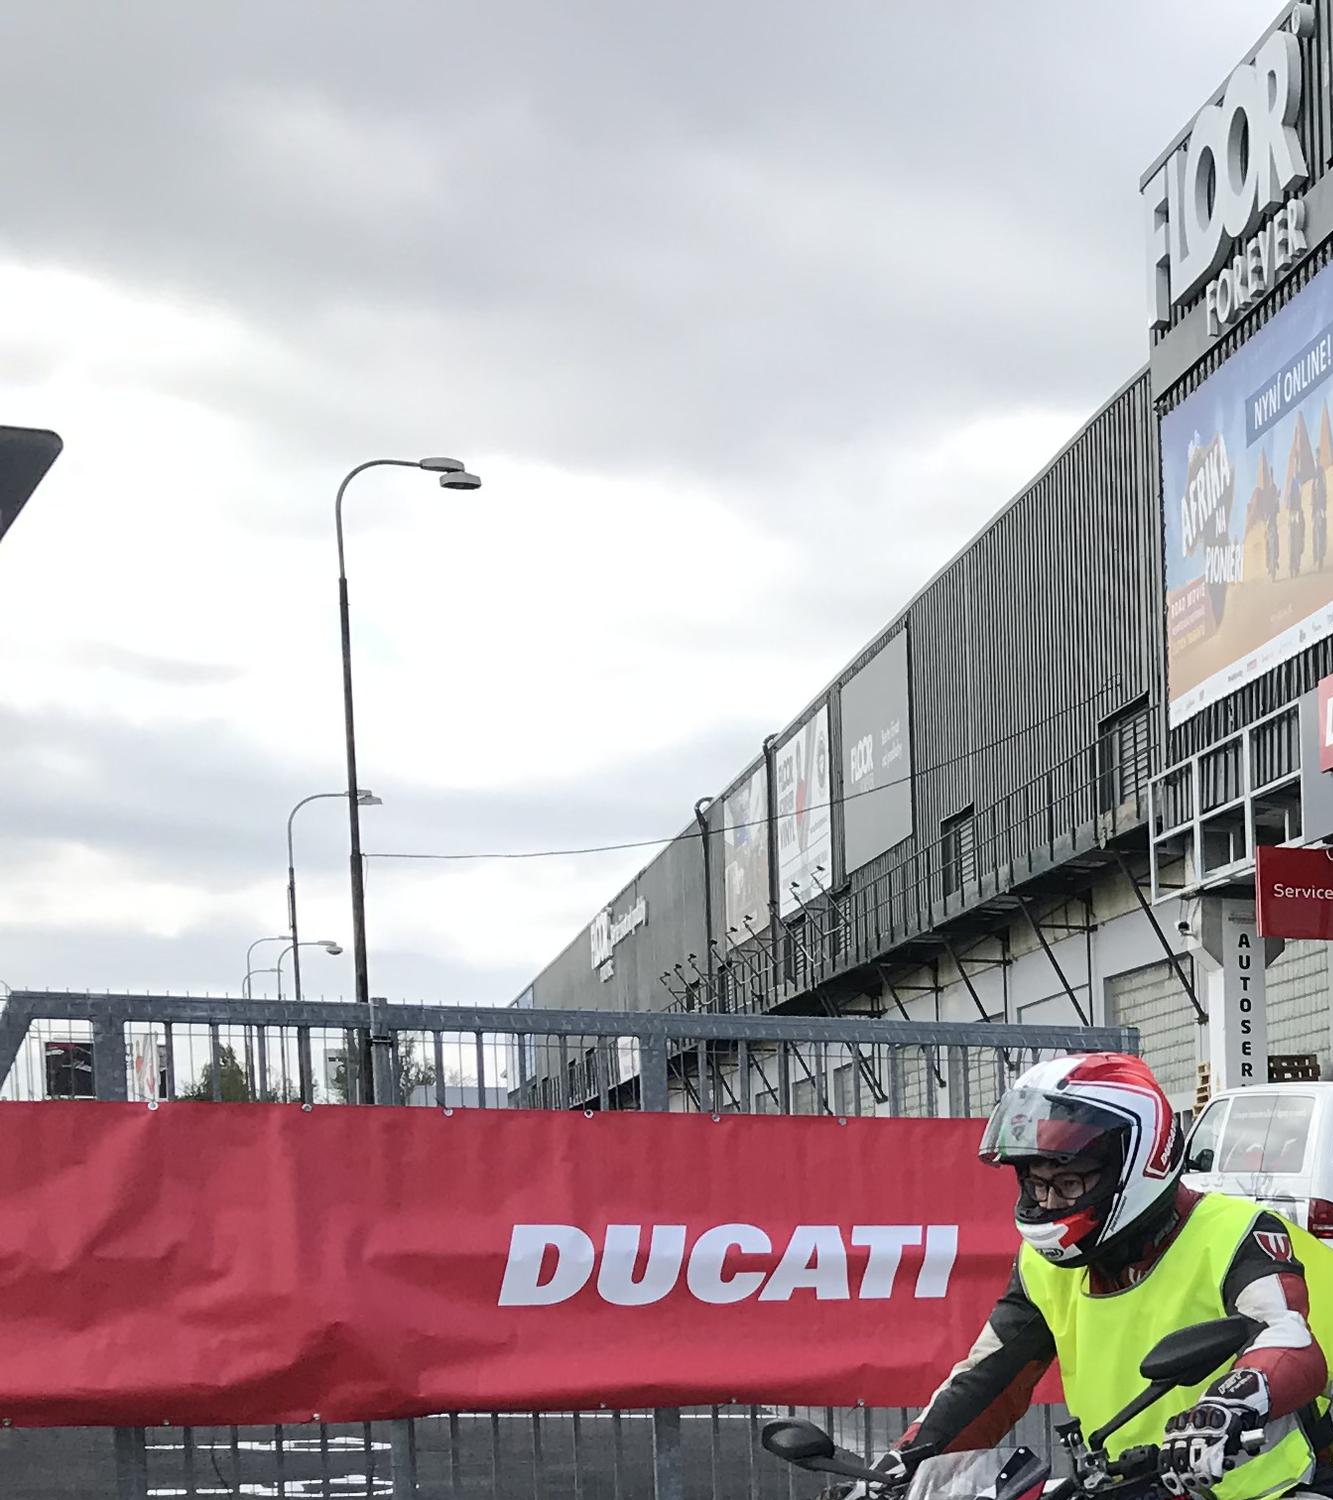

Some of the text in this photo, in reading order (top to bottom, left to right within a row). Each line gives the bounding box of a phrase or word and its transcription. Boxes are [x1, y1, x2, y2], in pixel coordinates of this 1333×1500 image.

[1206, 199, 1307, 337] FOREVER
[1253, 333, 1333, 429] NYNÍ ONLINE!
[1180, 432, 1231, 558] AFRIKA
[1273, 882, 1333, 900] Service
[1238, 933, 1253, 1088] AUTOSER
[498, 1223, 959, 1306] DUCATI
